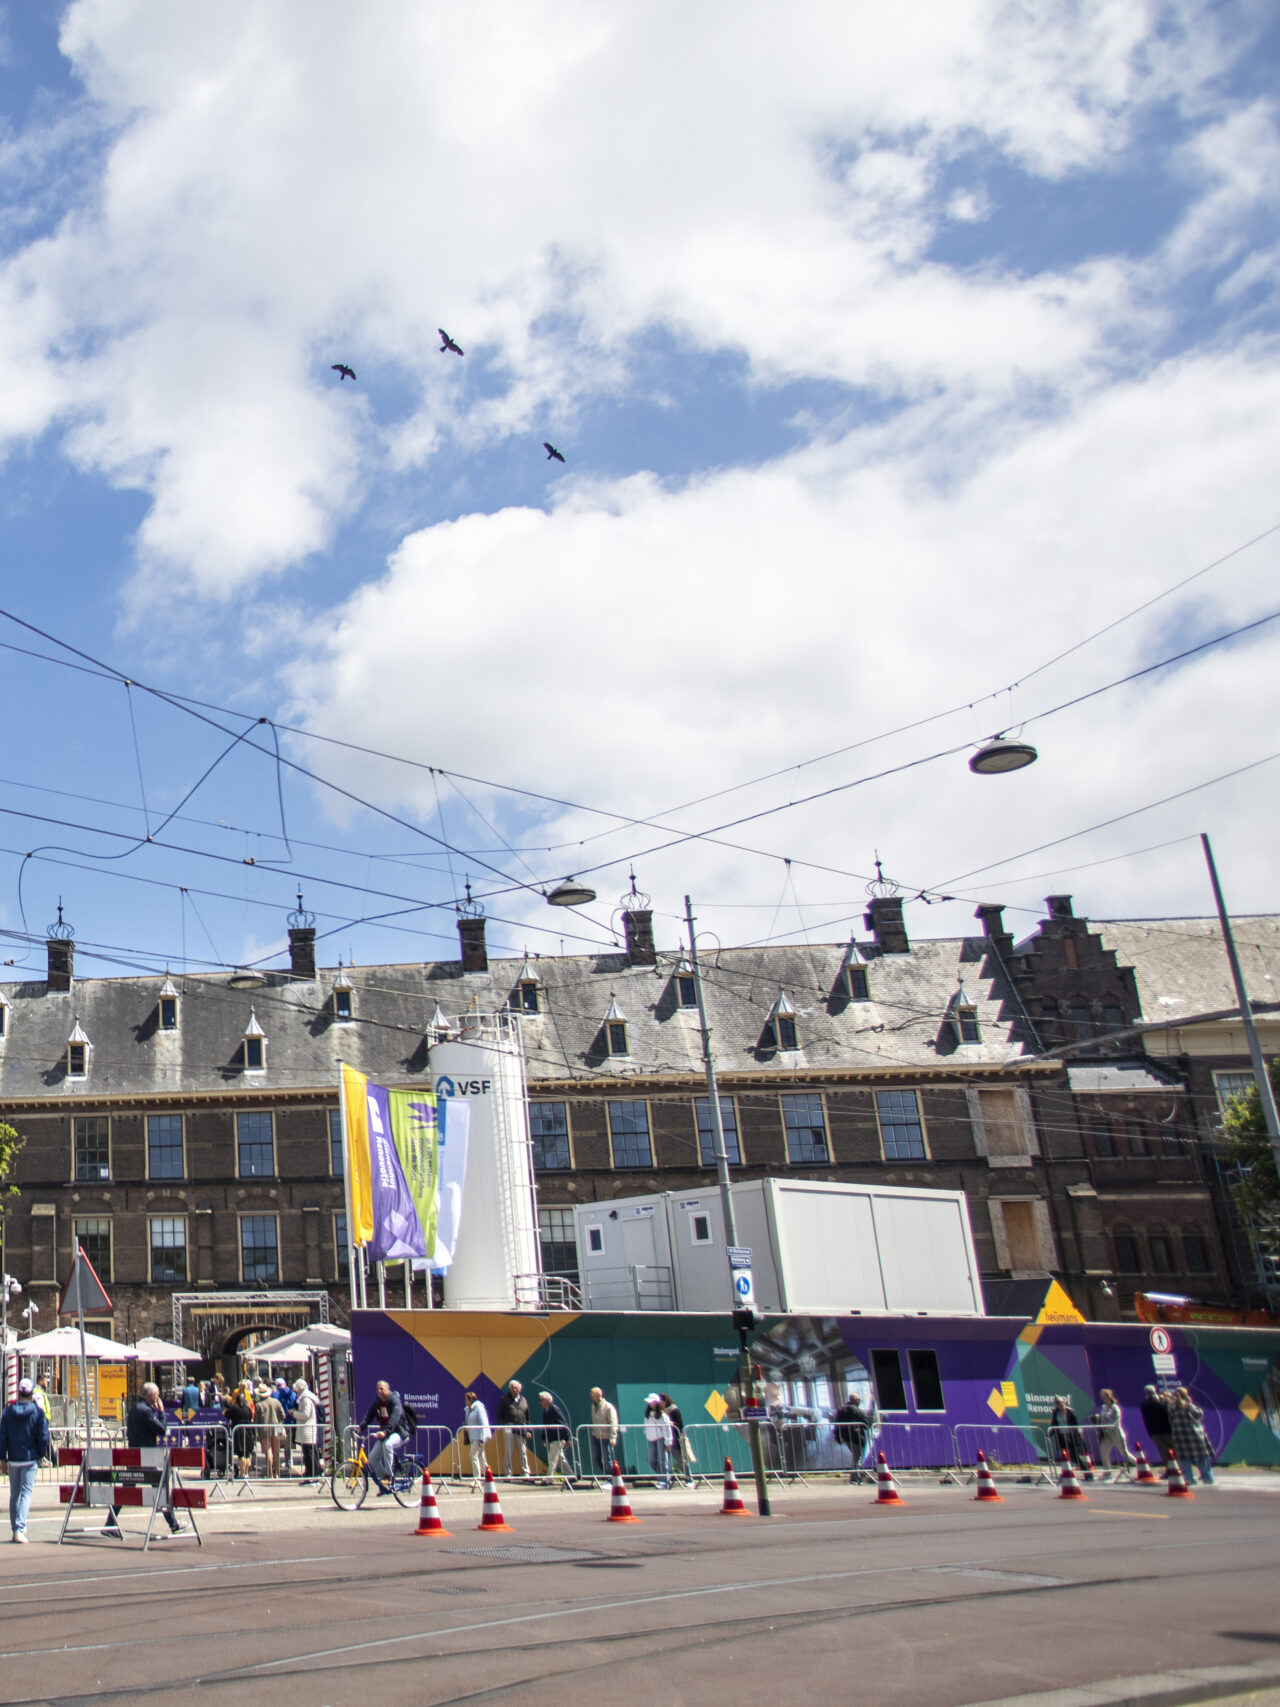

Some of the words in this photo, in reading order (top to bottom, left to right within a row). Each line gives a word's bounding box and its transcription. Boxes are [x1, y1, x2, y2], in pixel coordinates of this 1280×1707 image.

[458, 1080, 491, 1095] VSF
[376, 1136, 389, 1188] Renovatie
[1045, 1311, 1078, 1323] heijmans
[404, 1394, 439, 1402] Binnenhof
[1025, 1393, 1072, 1405] Binnenof
